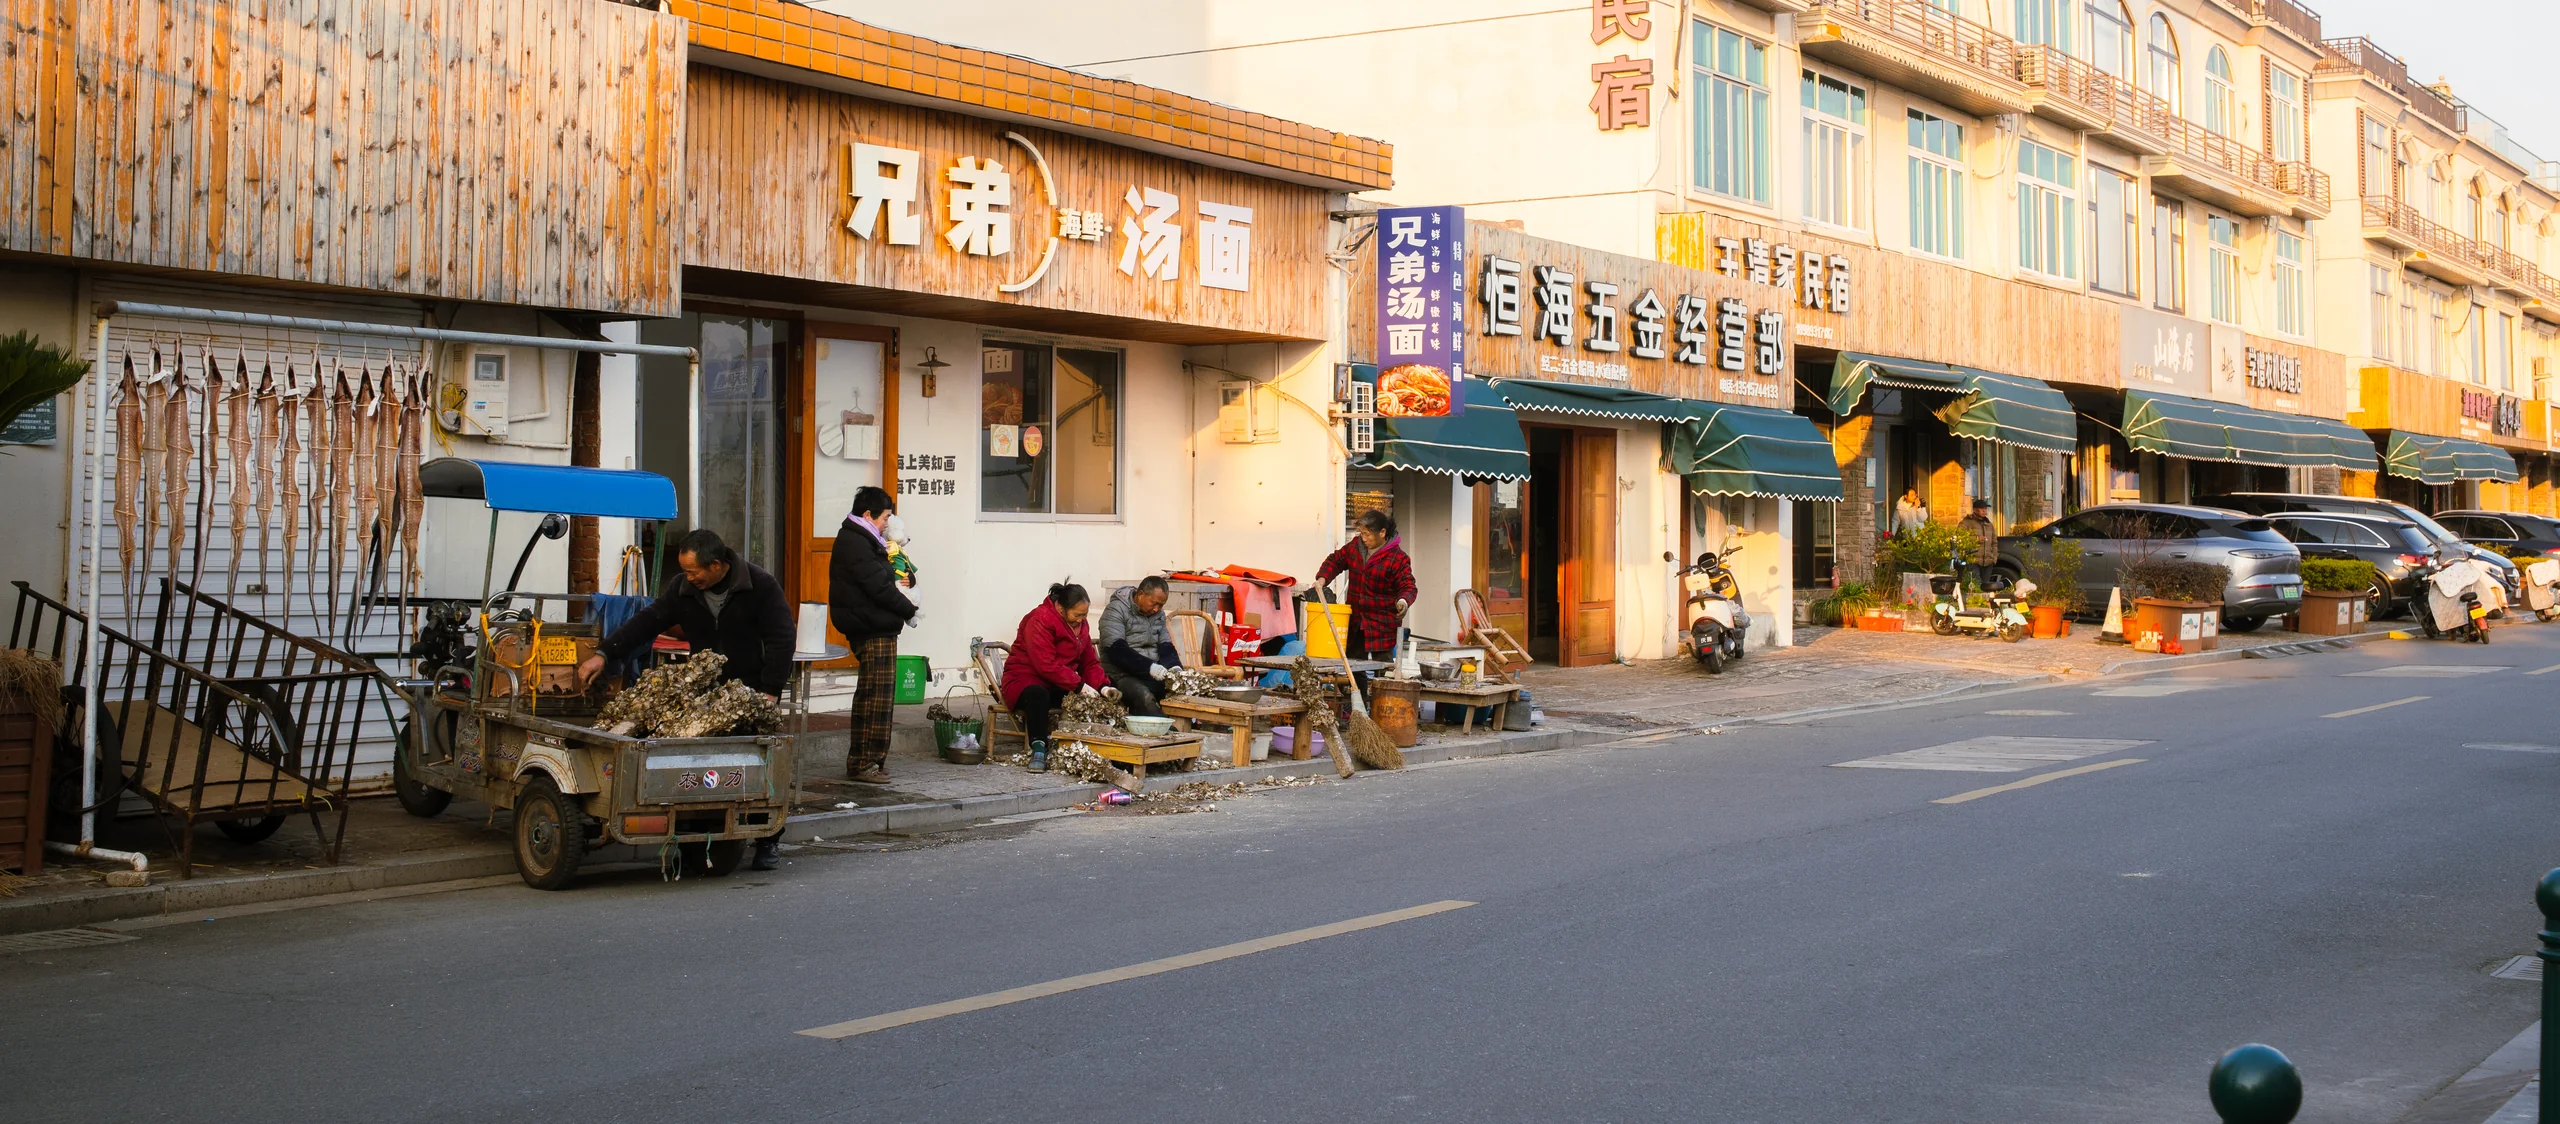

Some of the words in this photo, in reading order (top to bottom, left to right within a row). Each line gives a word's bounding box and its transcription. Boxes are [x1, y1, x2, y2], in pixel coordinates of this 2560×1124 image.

[1589, 0, 1653, 130] 民宿
[847, 143, 1010, 256] 兄弟
[1119, 184, 1253, 292] 汤面
[1386, 216, 1427, 355] 兄弟汤面
[1452, 240, 1462, 382] 特色海鲜面
[1479, 254, 1784, 375] 恒海五金经营部
[678, 771, 699, 790] 农
[723, 769, 743, 788] 力
